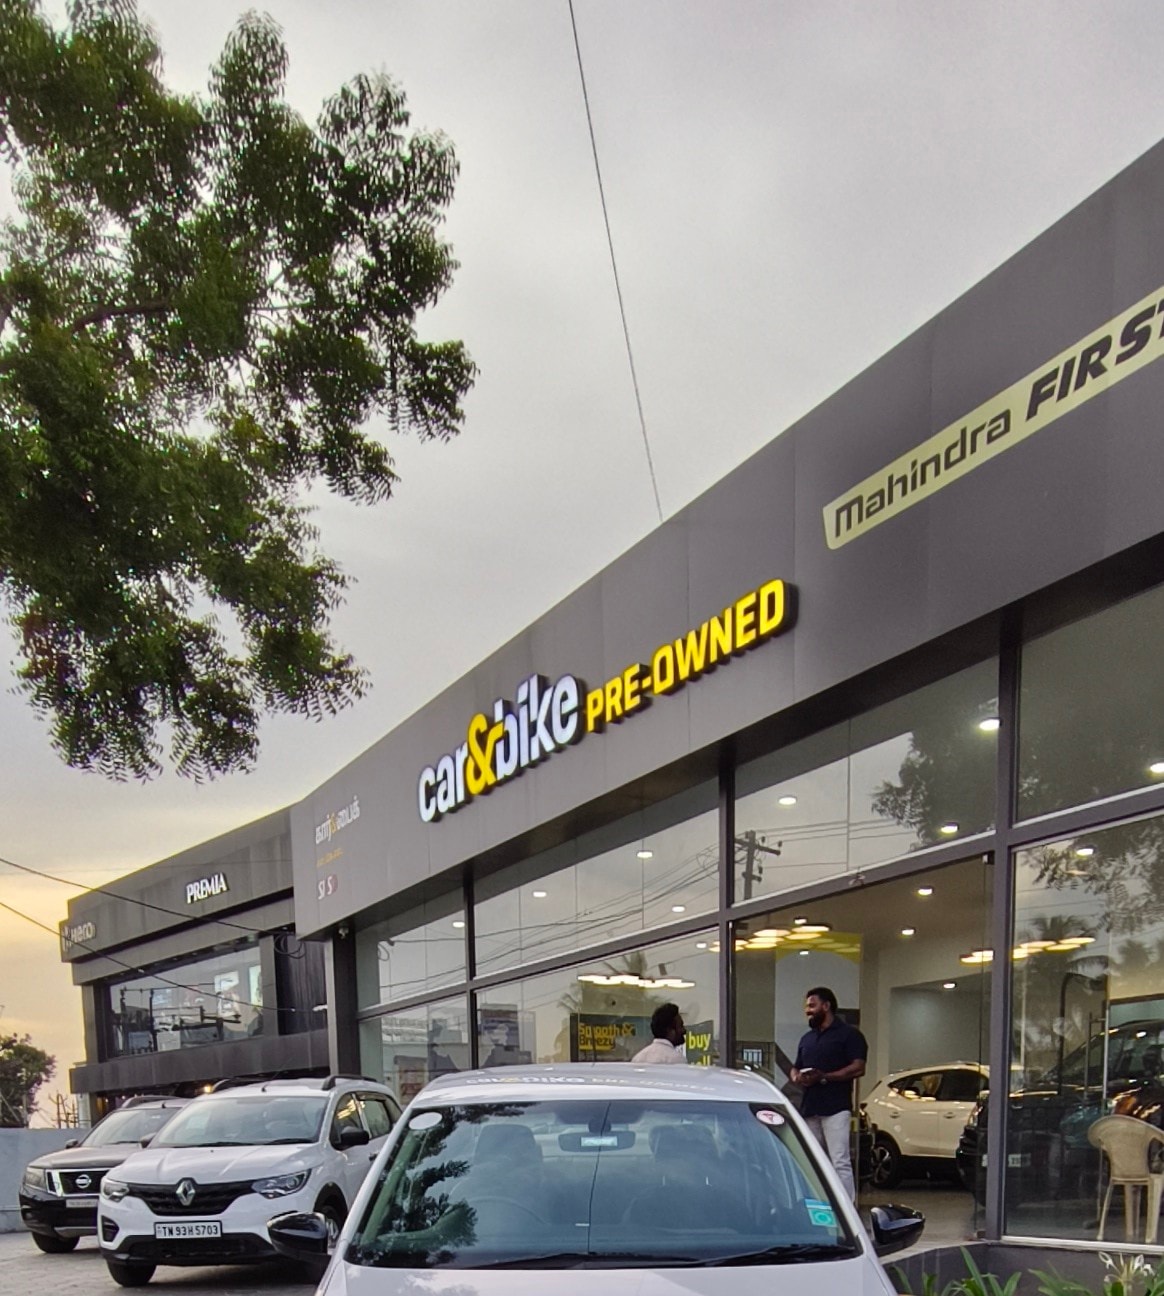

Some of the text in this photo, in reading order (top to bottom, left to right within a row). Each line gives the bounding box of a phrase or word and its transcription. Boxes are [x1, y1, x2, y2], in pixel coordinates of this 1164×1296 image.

[835, 408, 1011, 538] Mahindra
[418, 578, 786, 823] car&bike PRE-OWNED
[186, 872, 228, 904] PREMIA
[688, 1030, 711, 1051] buy
